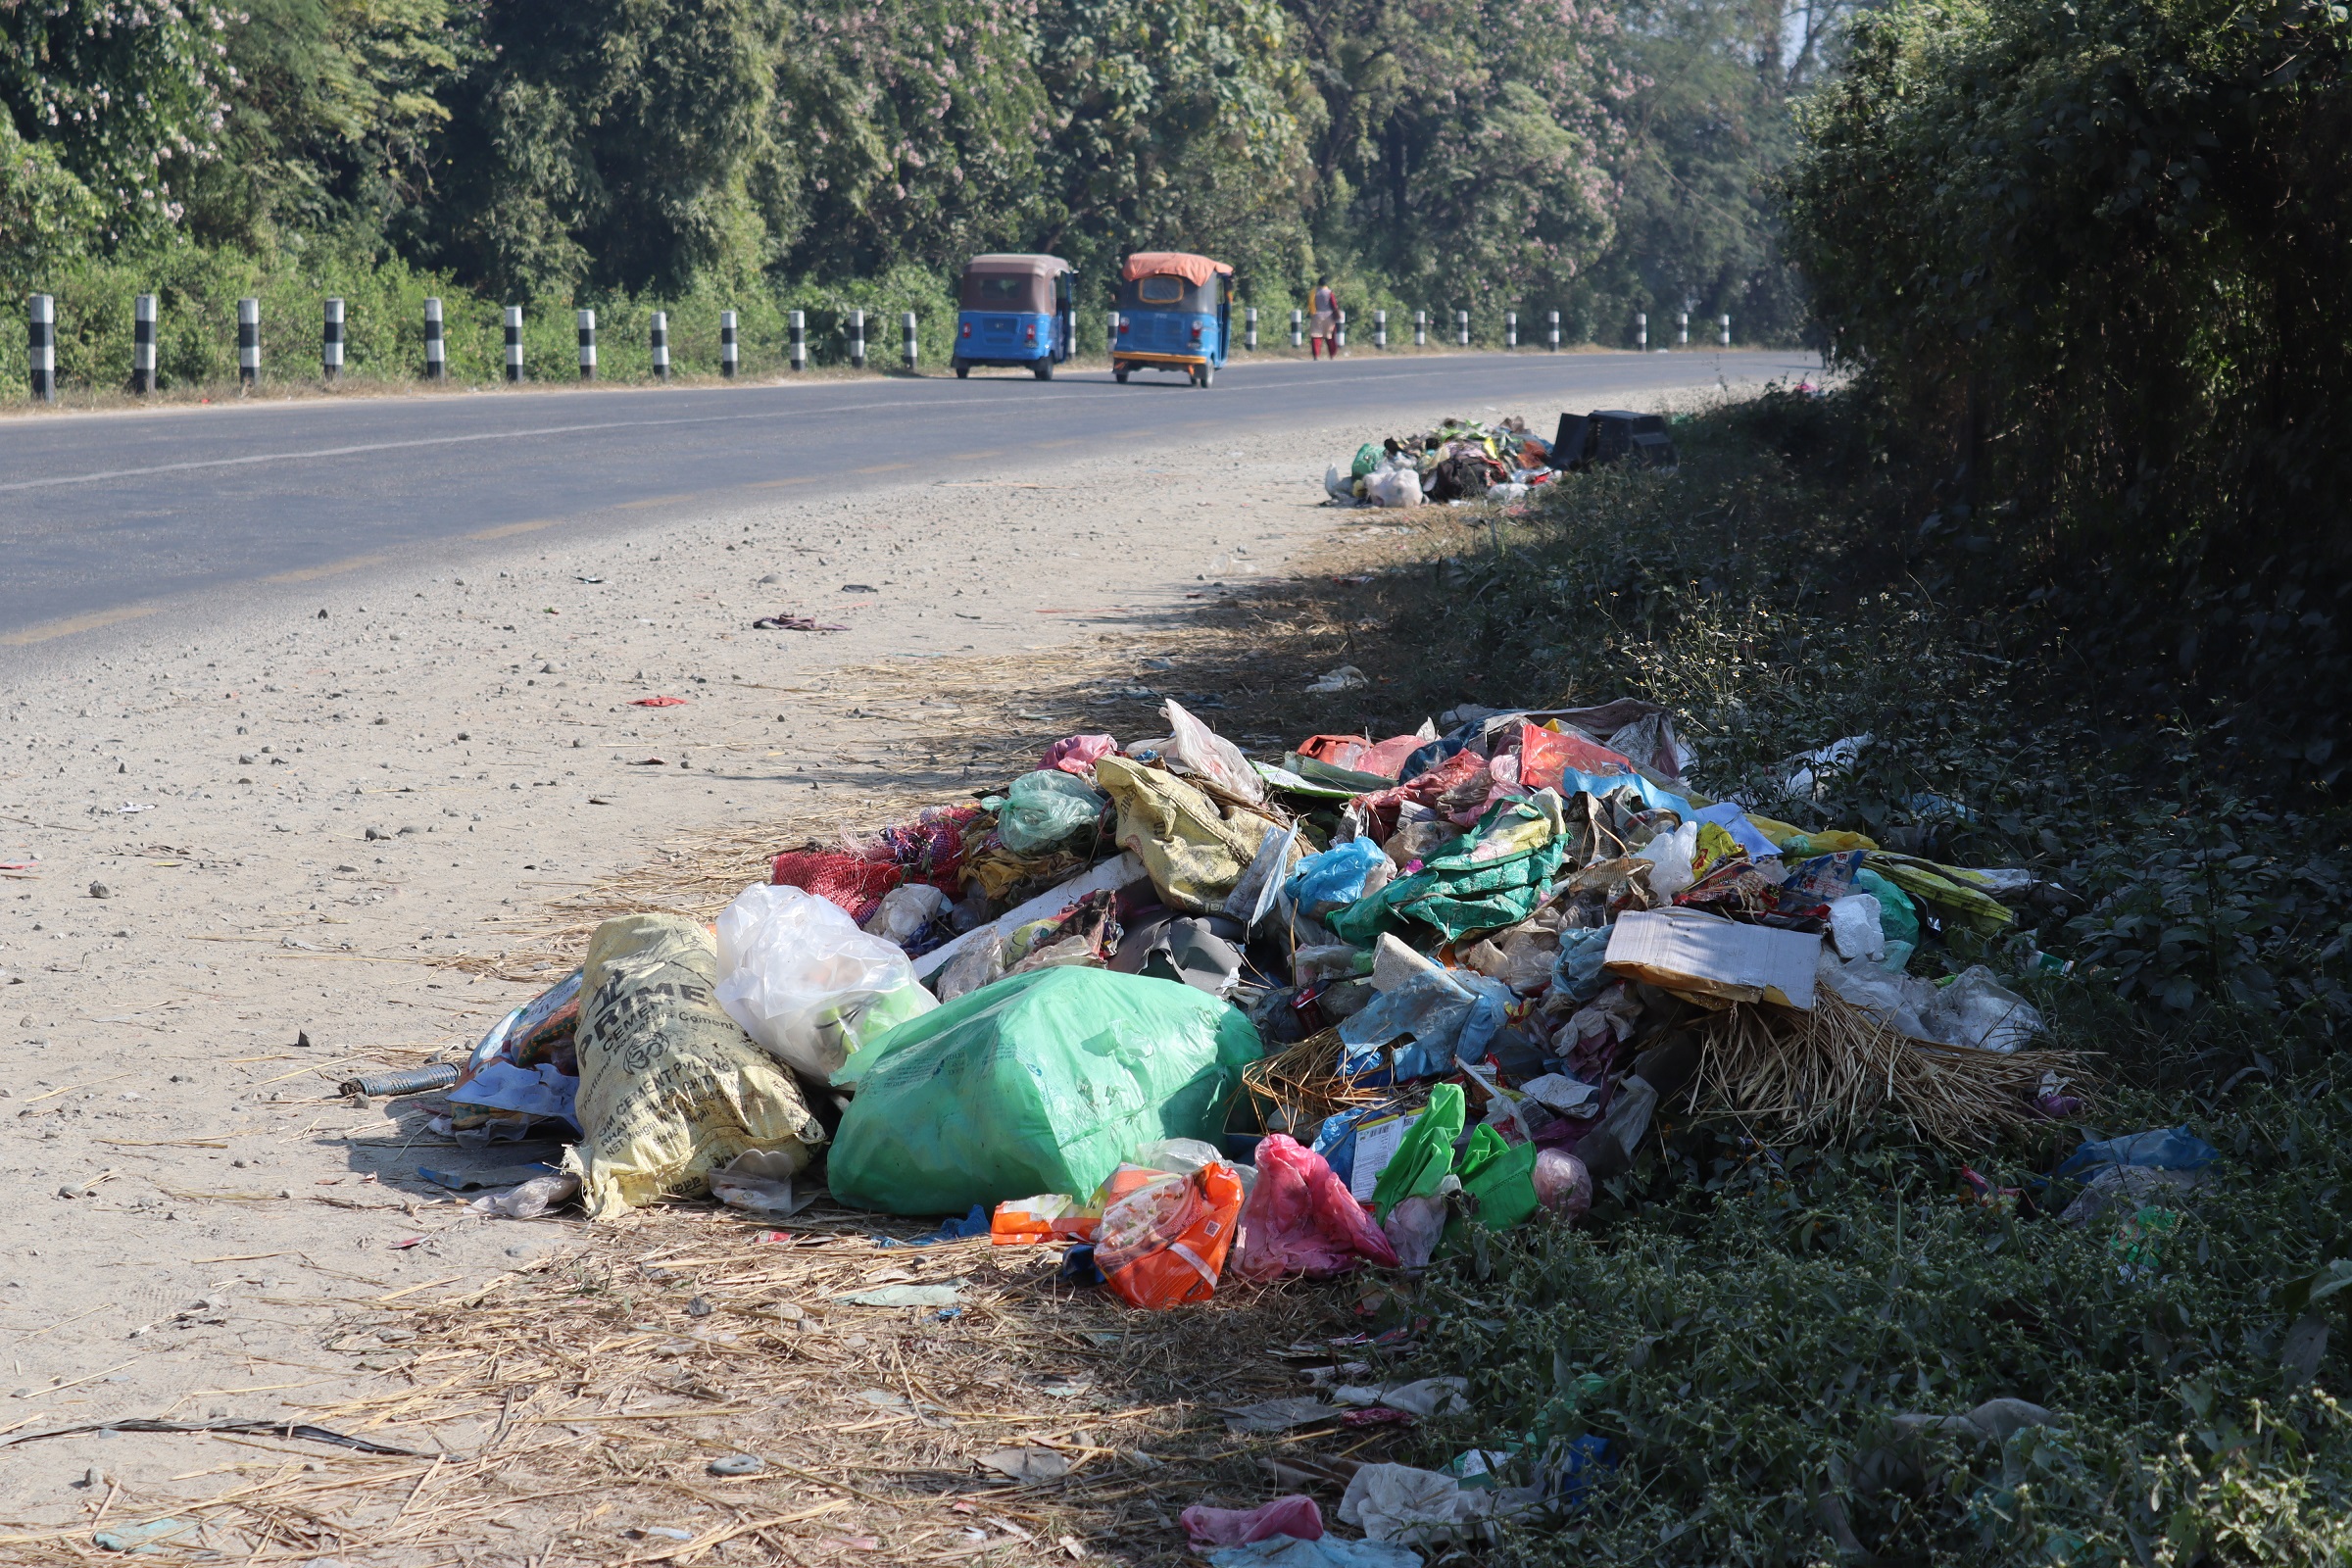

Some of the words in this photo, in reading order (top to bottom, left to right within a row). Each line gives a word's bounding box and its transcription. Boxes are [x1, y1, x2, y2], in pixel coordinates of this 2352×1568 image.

[578, 983, 709, 1069] PRIME
[603, 999, 676, 1052] CEMENT
[606, 1138, 625, 1157] NET
